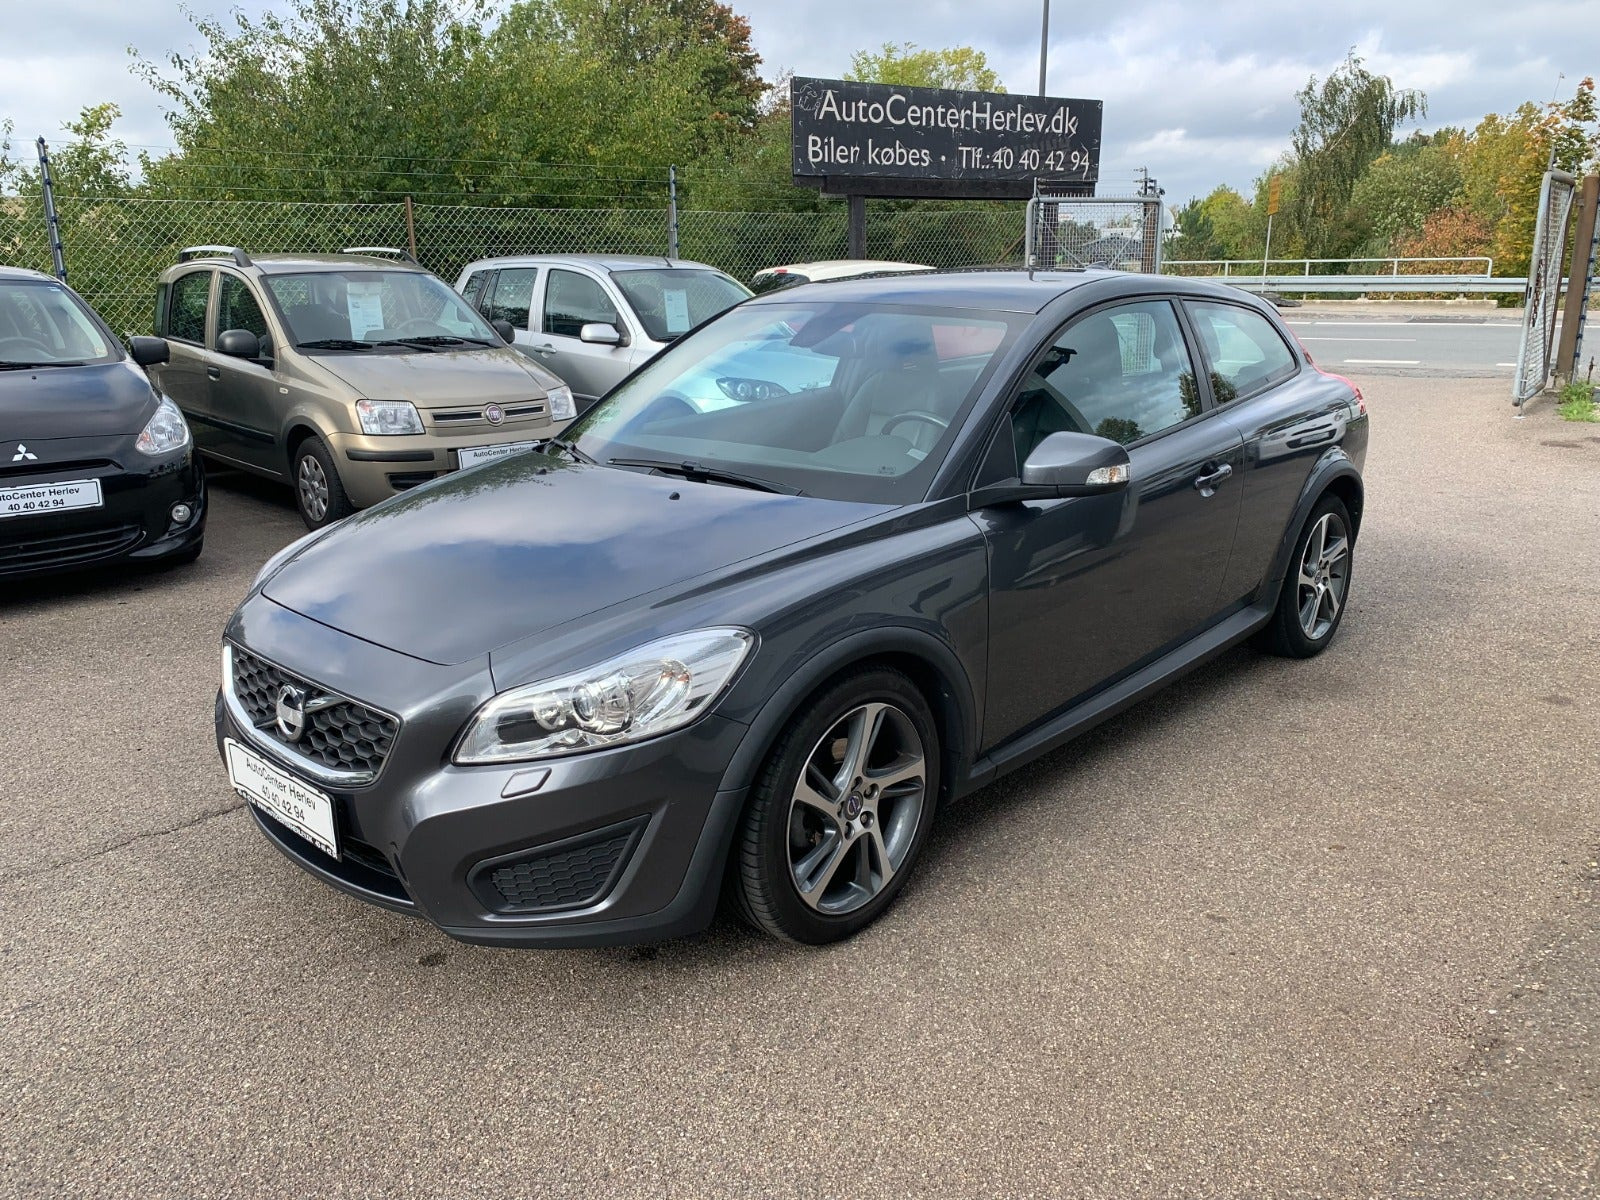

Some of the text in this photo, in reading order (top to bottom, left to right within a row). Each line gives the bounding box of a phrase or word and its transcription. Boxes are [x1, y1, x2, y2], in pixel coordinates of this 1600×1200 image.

[819, 90, 1079, 137] AutoCenterHerlev.dk
[808, 134, 860, 164] Biler
[868, 138, 930, 166] købes
[1019, 149, 1040, 171] 40
[1045, 151, 1065, 171] 42
[1071, 151, 1090, 174] 94
[8, 499, 64, 511] 40 40 42 94
[48, 487, 80, 497] Herlev
[246, 757, 287, 793] AutoCenter
[289, 783, 316, 811] Herlev
[262, 784, 271, 800] 40
[271, 791, 281, 808] 40
[282, 799, 293, 815] 42
[293, 805, 305, 822] 94
